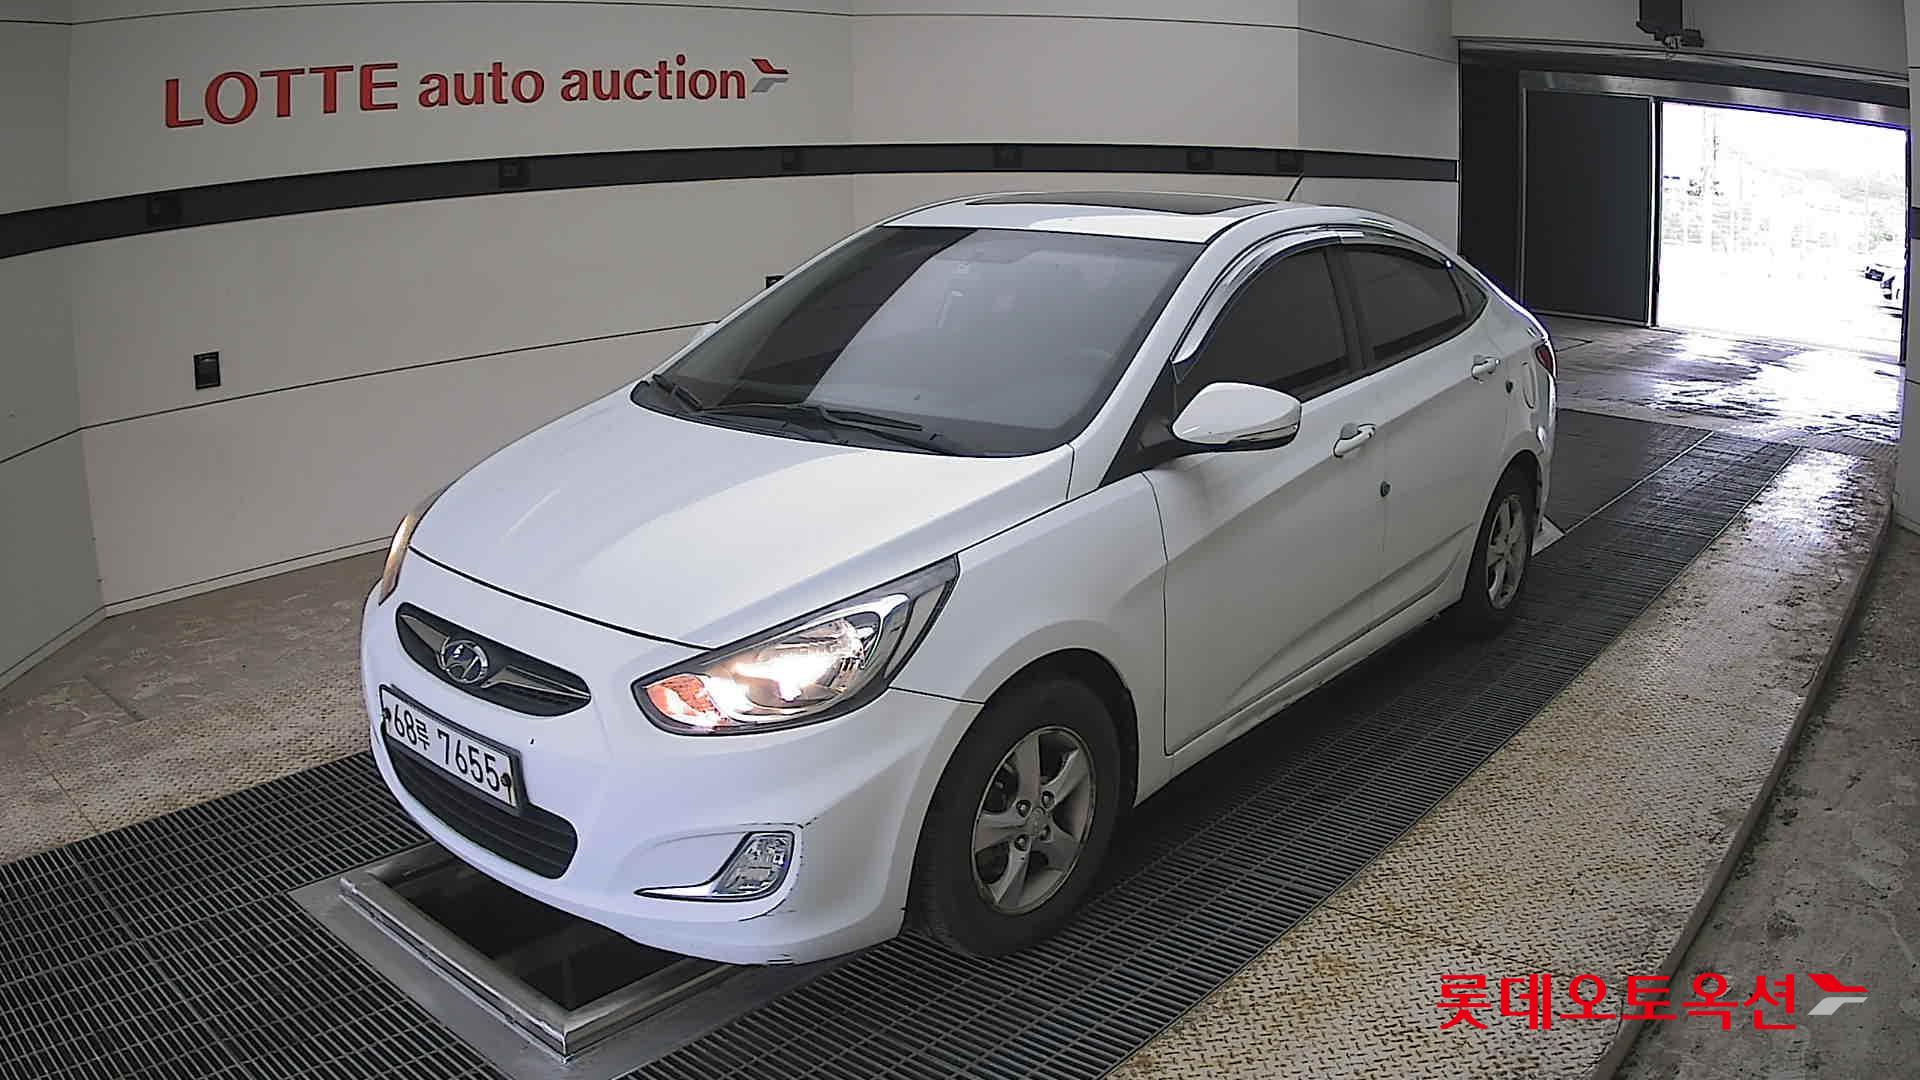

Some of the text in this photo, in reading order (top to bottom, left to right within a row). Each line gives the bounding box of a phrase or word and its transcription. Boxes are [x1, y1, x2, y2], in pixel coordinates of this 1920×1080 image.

[165, 54, 746, 128] LOTTE auto auction
[394, 704, 501, 792] 68루 7655
